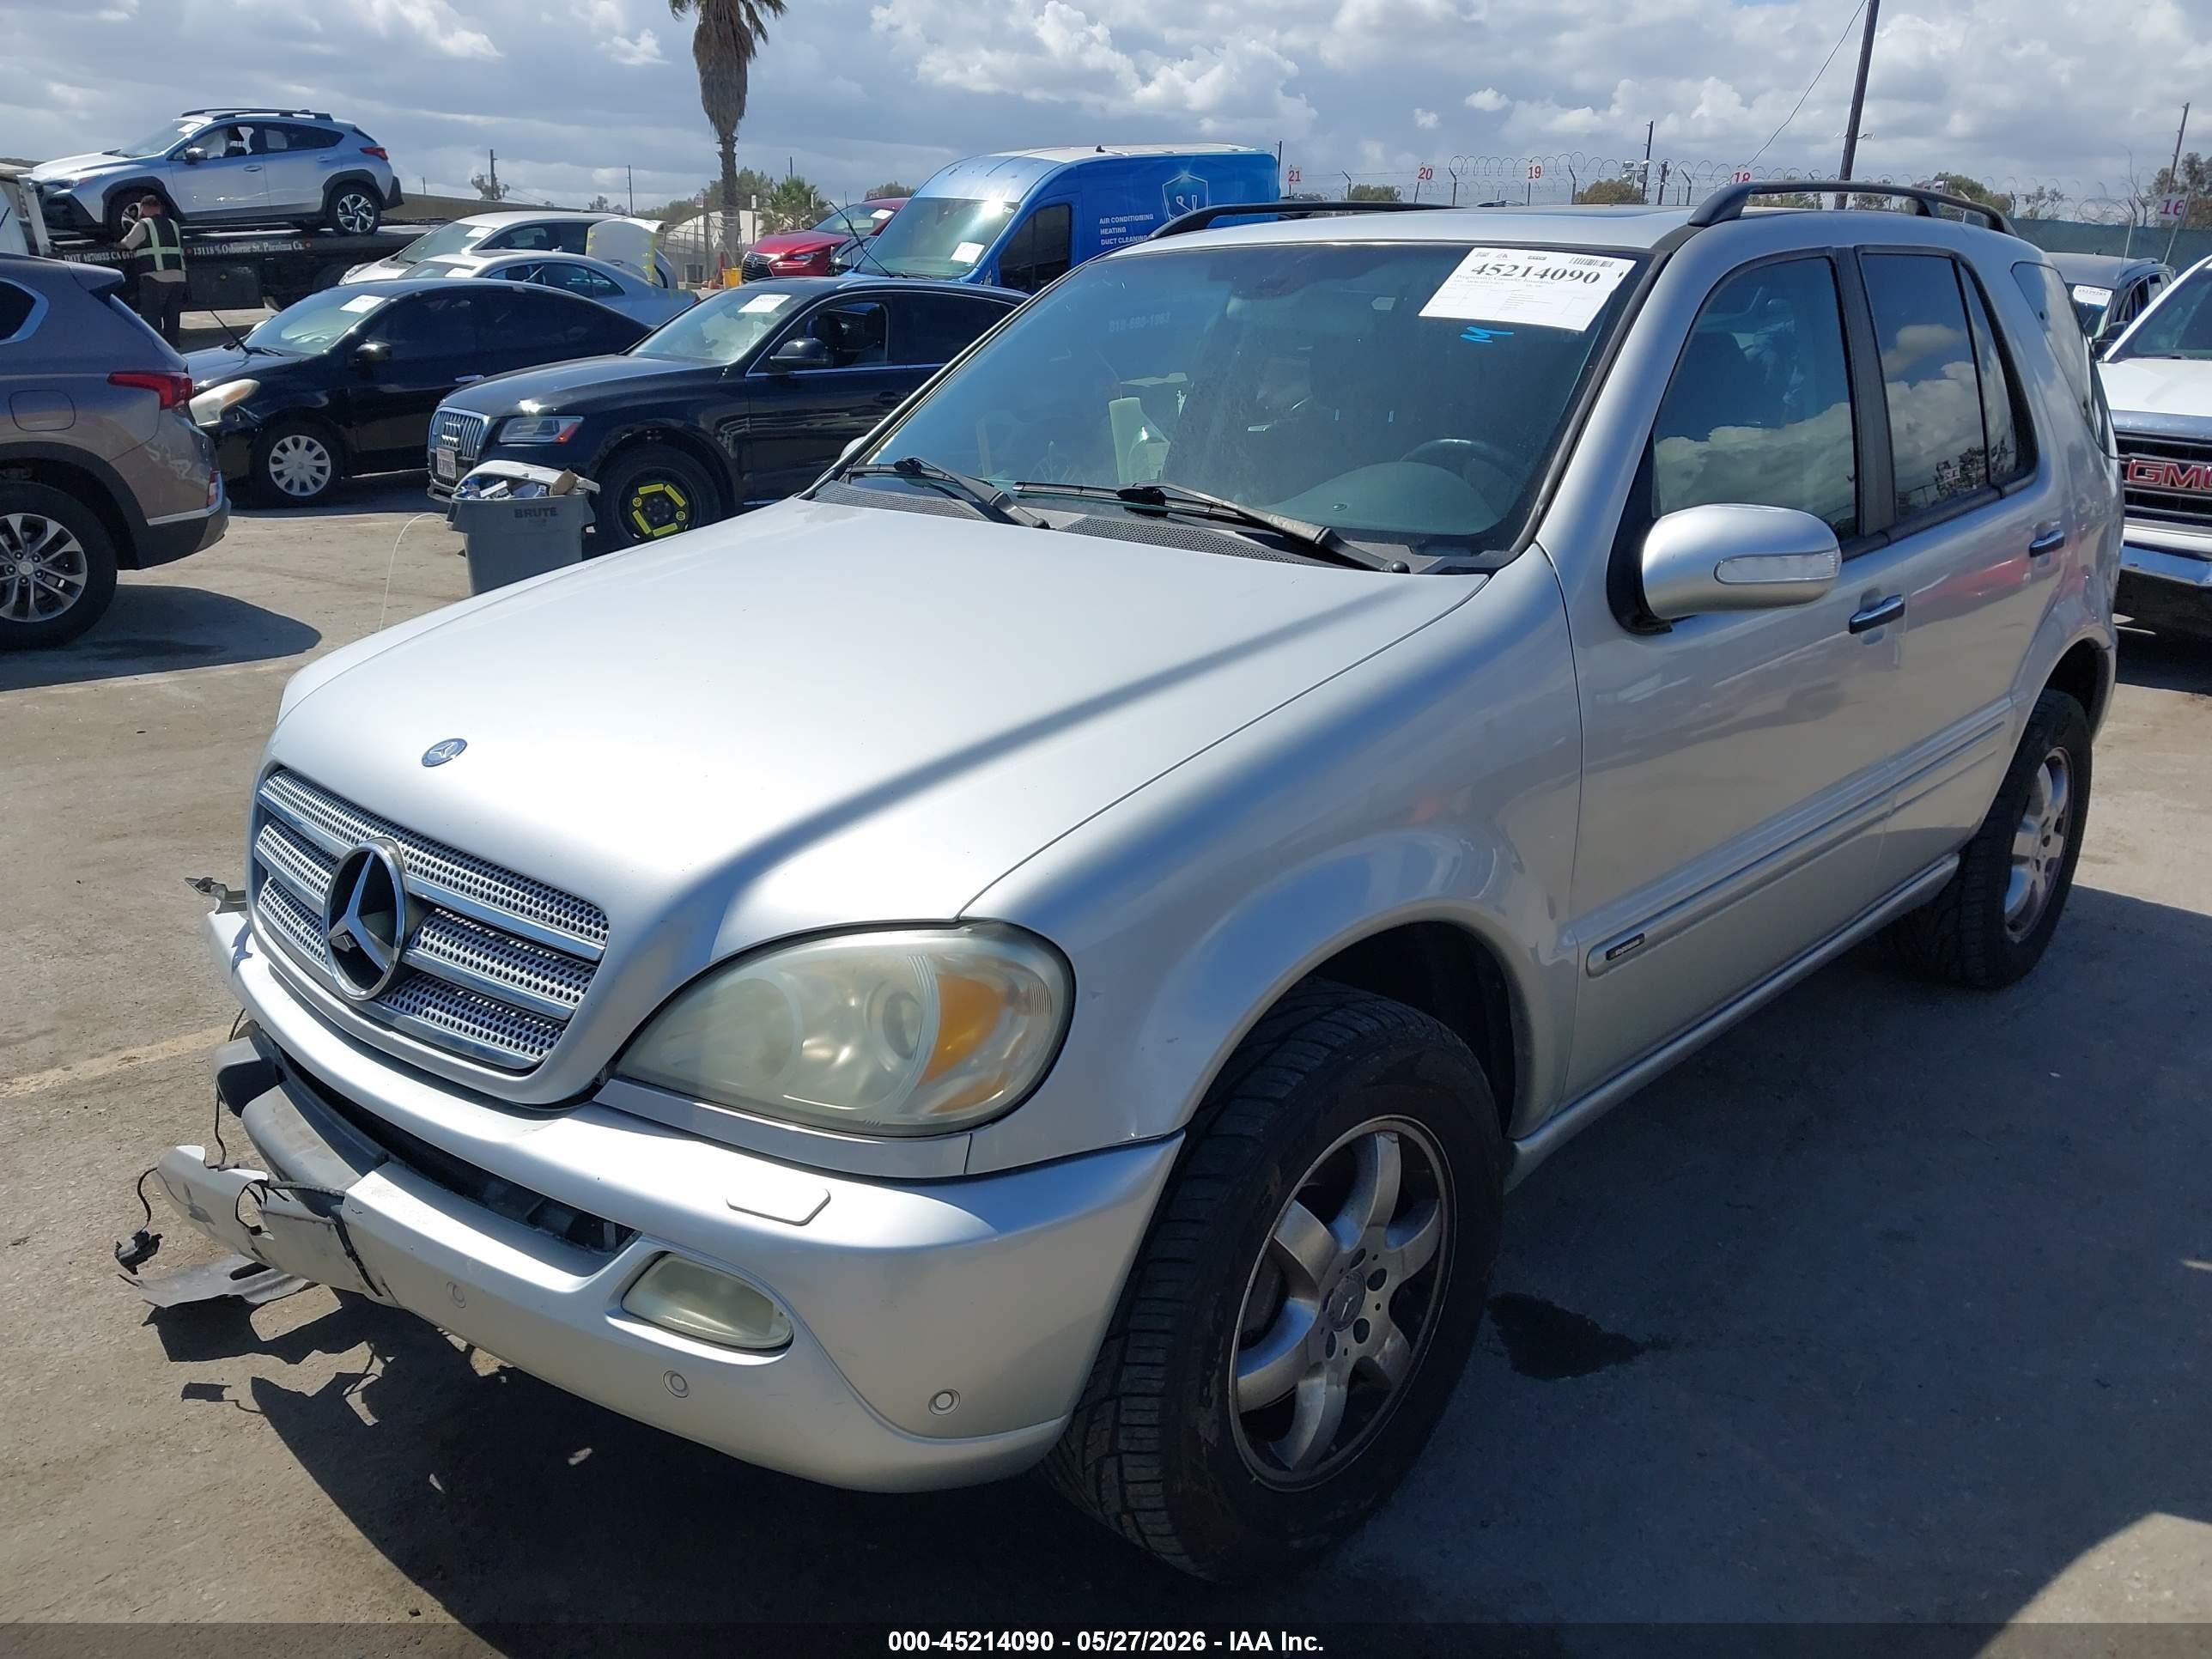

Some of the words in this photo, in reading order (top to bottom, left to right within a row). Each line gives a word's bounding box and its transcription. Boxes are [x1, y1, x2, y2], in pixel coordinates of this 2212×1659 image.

[1288, 169, 1301, 181] 21
[1418, 167, 1433, 180] 20
[1528, 165, 1541, 179] 19
[1734, 171, 1751, 183] 18
[2159, 198, 2185, 216] 16
[1110, 213, 1154, 223] CONDITIONING
[1100, 226, 1127, 235] HEATING
[1471, 263, 1601, 284] 45214090
[514, 507, 558, 519] BRUTE
